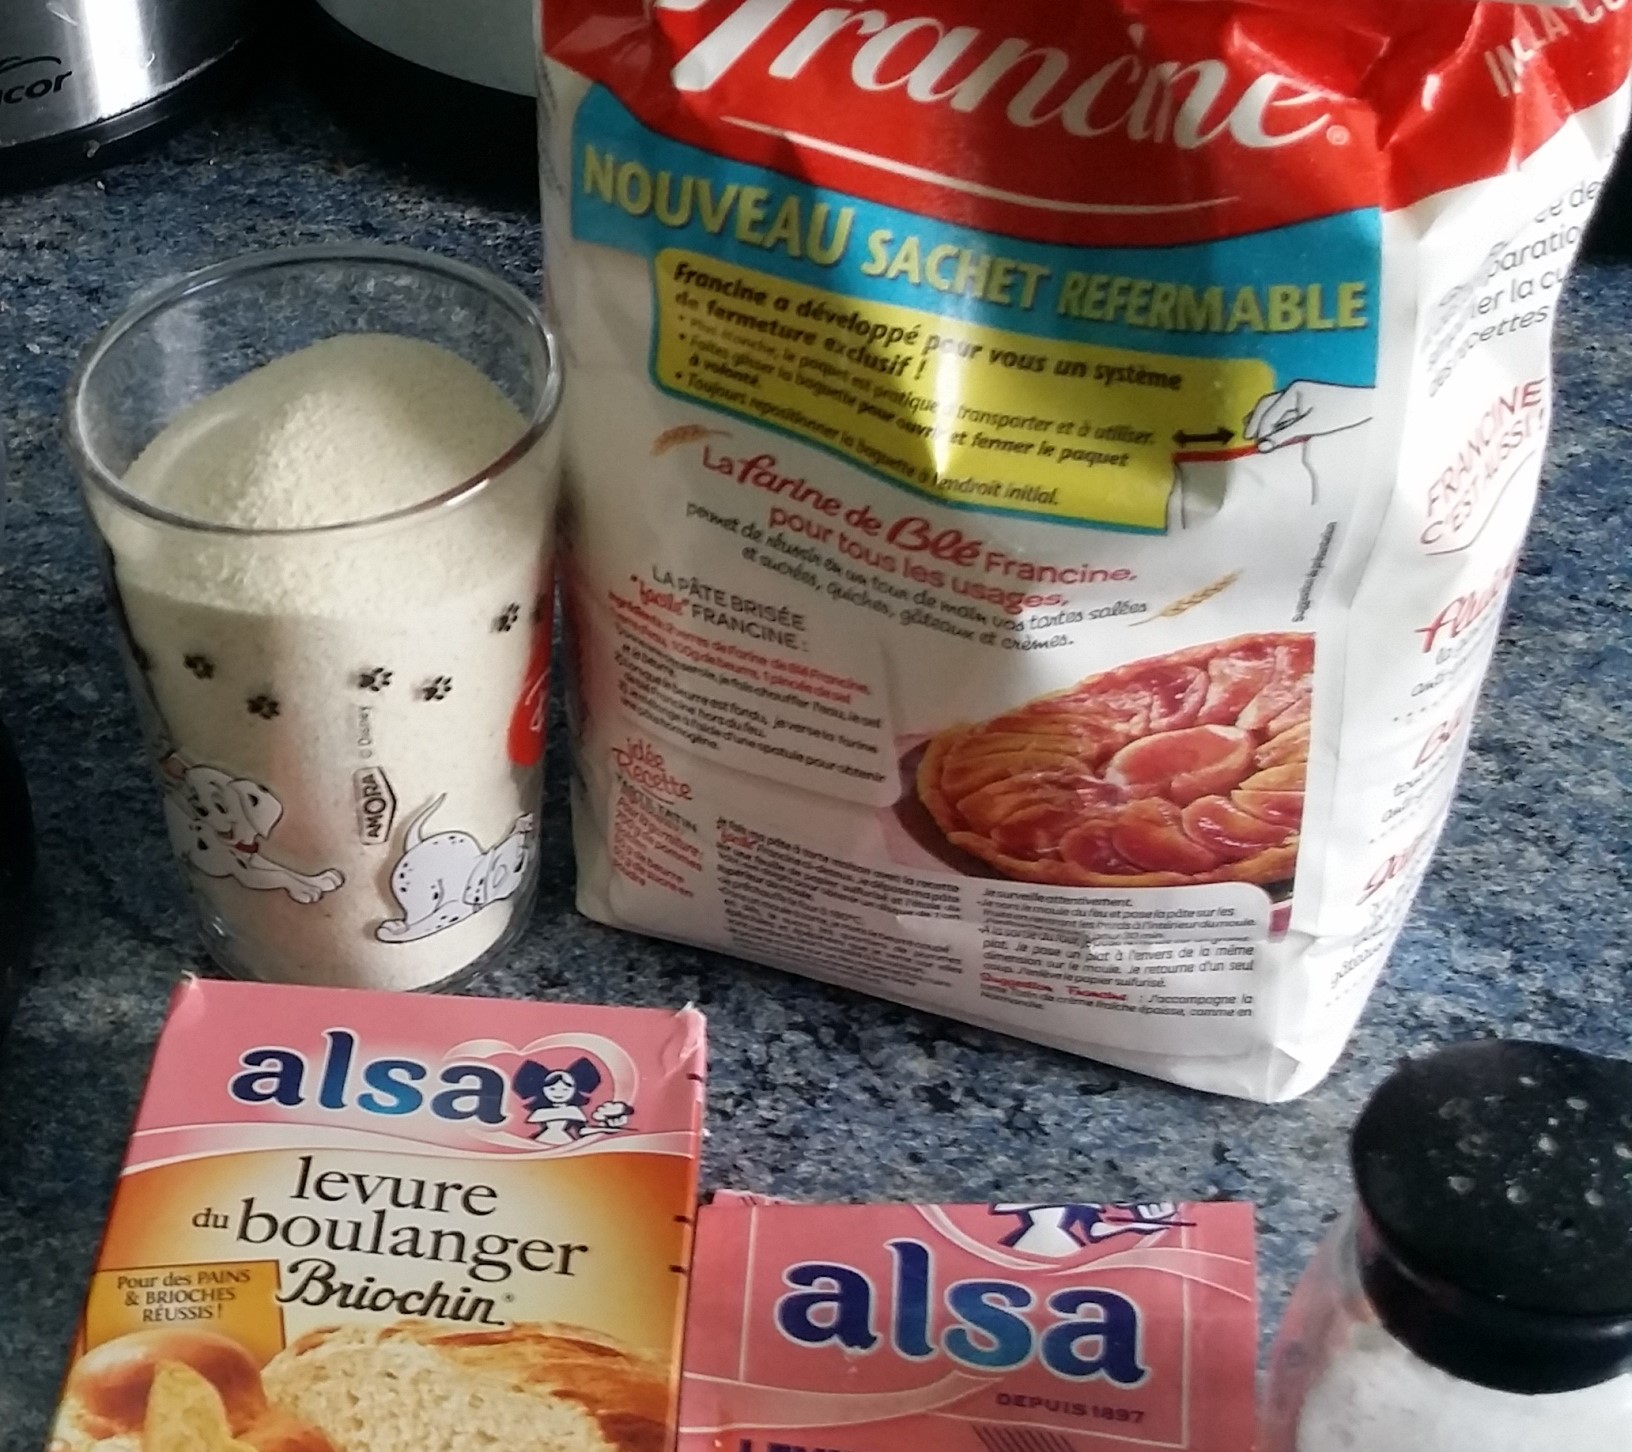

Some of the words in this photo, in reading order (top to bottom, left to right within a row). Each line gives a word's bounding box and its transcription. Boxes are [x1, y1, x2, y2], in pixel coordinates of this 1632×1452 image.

[581, 144, 856, 266] NOUVEAU
[861, 229, 1051, 311] SACHET
[1058, 271, 1367, 334] REFERMABLE
[674, 262, 768, 307] Francine
[774, 297, 790, 312] a
[795, 300, 920, 347] développé
[922, 334, 982, 358] pour
[989, 349, 1047, 373] vous
[1053, 359, 1087, 378] un
[1093, 362, 1183, 391] système
[706, 299, 817, 345] fermeture
[824, 336, 914, 377] exclusif
[970, 431, 1034, 456] fermer
[1058, 447, 1129, 469] paquet
[703, 445, 733, 475] La
[737, 453, 842, 516] farine
[845, 505, 882, 537] de
[886, 516, 983, 567] Blé
[984, 552, 1138, 585] Francine,
[768, 506, 833, 543] pour
[838, 531, 897, 574] tous
[903, 557, 945, 589] les
[951, 577, 1070, 616] usages,
[652, 565, 676, 590] LA
[678, 576, 727, 609] PÂTE
[730, 595, 807, 633] BRISÉE
[690, 603, 799, 650] FRANCINE
[1028, 606, 1084, 630] tartes
[1088, 599, 1148, 621] salées
[361, 773, 388, 838] AMORA
[228, 1027, 513, 1128] alsa
[290, 1155, 498, 1217] levure
[191, 1206, 229, 1230] du
[236, 1196, 589, 1284] boulanger
[118, 1275, 159, 1289] Pour
[163, 1271, 192, 1286] des
[197, 1268, 252, 1285] PAINS
[124, 1290, 139, 1306] &
[146, 1286, 236, 1305] BRIOCHES
[142, 1303, 214, 1322] RÉUSSIS
[275, 1257, 505, 1326] Briochin
[774, 1237, 1152, 1391] alsa
[996, 1392, 1088, 1416] DEPUIS
[1092, 1404, 1145, 1423] 1897
